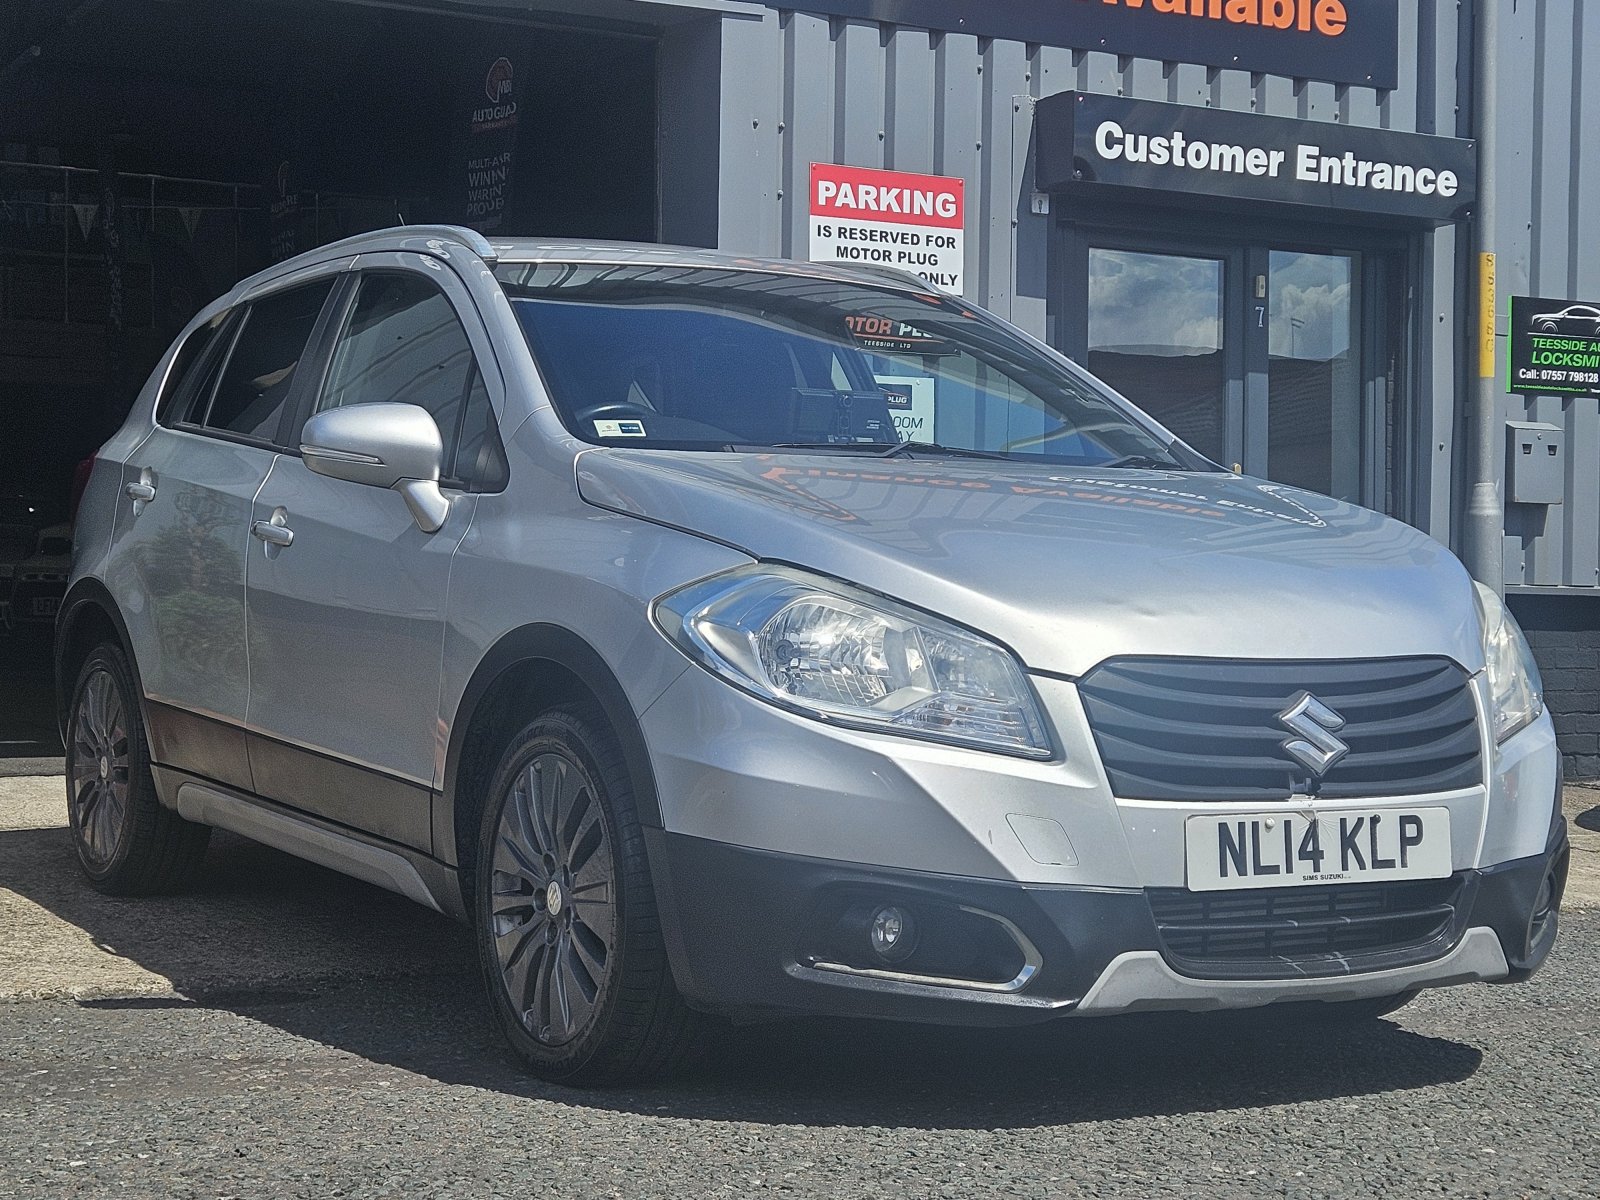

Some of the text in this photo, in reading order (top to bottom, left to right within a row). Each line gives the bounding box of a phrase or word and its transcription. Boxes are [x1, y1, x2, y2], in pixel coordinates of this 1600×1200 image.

[1094, 120, 1459, 197] Customer Entrance
[817, 180, 957, 218] PARKING
[817, 224, 956, 250] IS RESERVED FOR
[836, 245, 938, 266] MOTOR PLUG
[1254, 306, 1265, 328] 7
[1532, 337, 1587, 352] TEESSIDE
[1519, 368, 1599, 383] Call: 07557 798128
[1217, 813, 1425, 878] NL14 KLP
